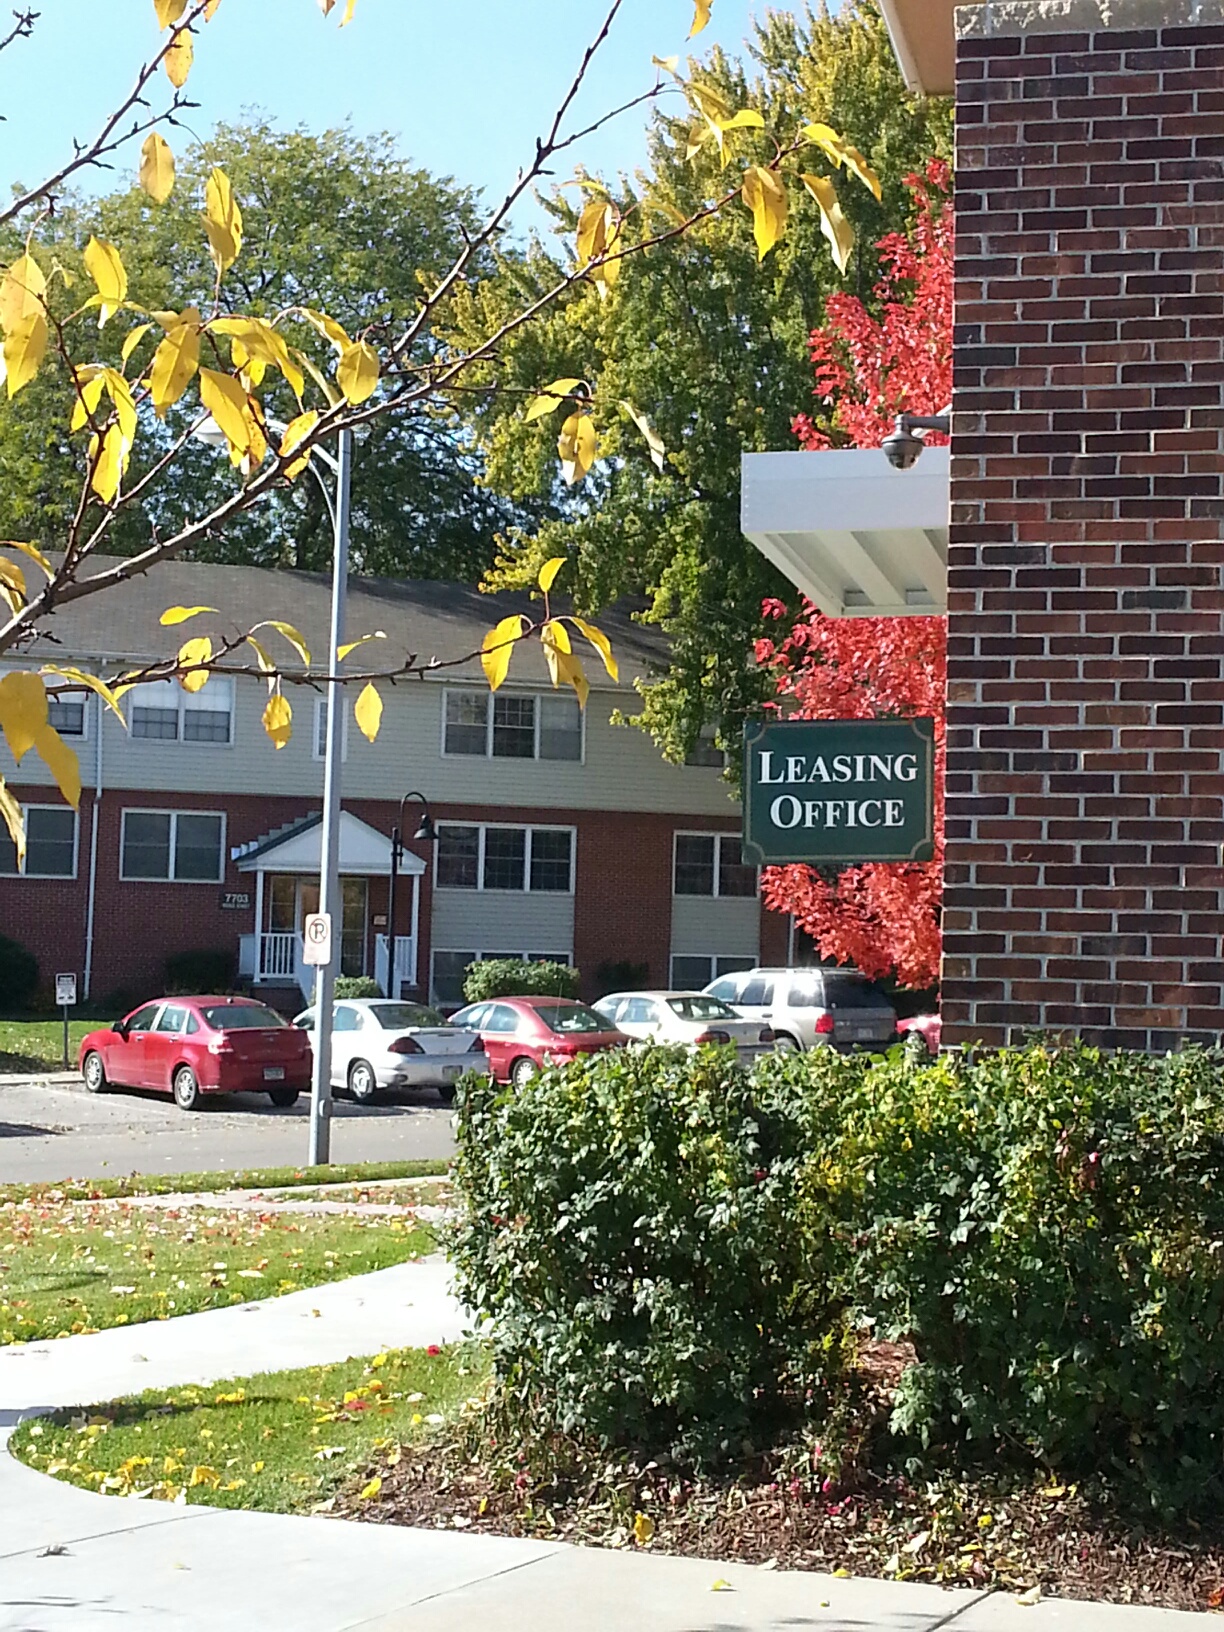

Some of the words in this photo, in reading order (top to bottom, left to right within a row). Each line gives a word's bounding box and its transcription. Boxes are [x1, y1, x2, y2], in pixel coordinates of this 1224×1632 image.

[757, 750, 918, 784] LEASING
[770, 794, 905, 829] OFFICE
[225, 893, 249, 903] 7703
